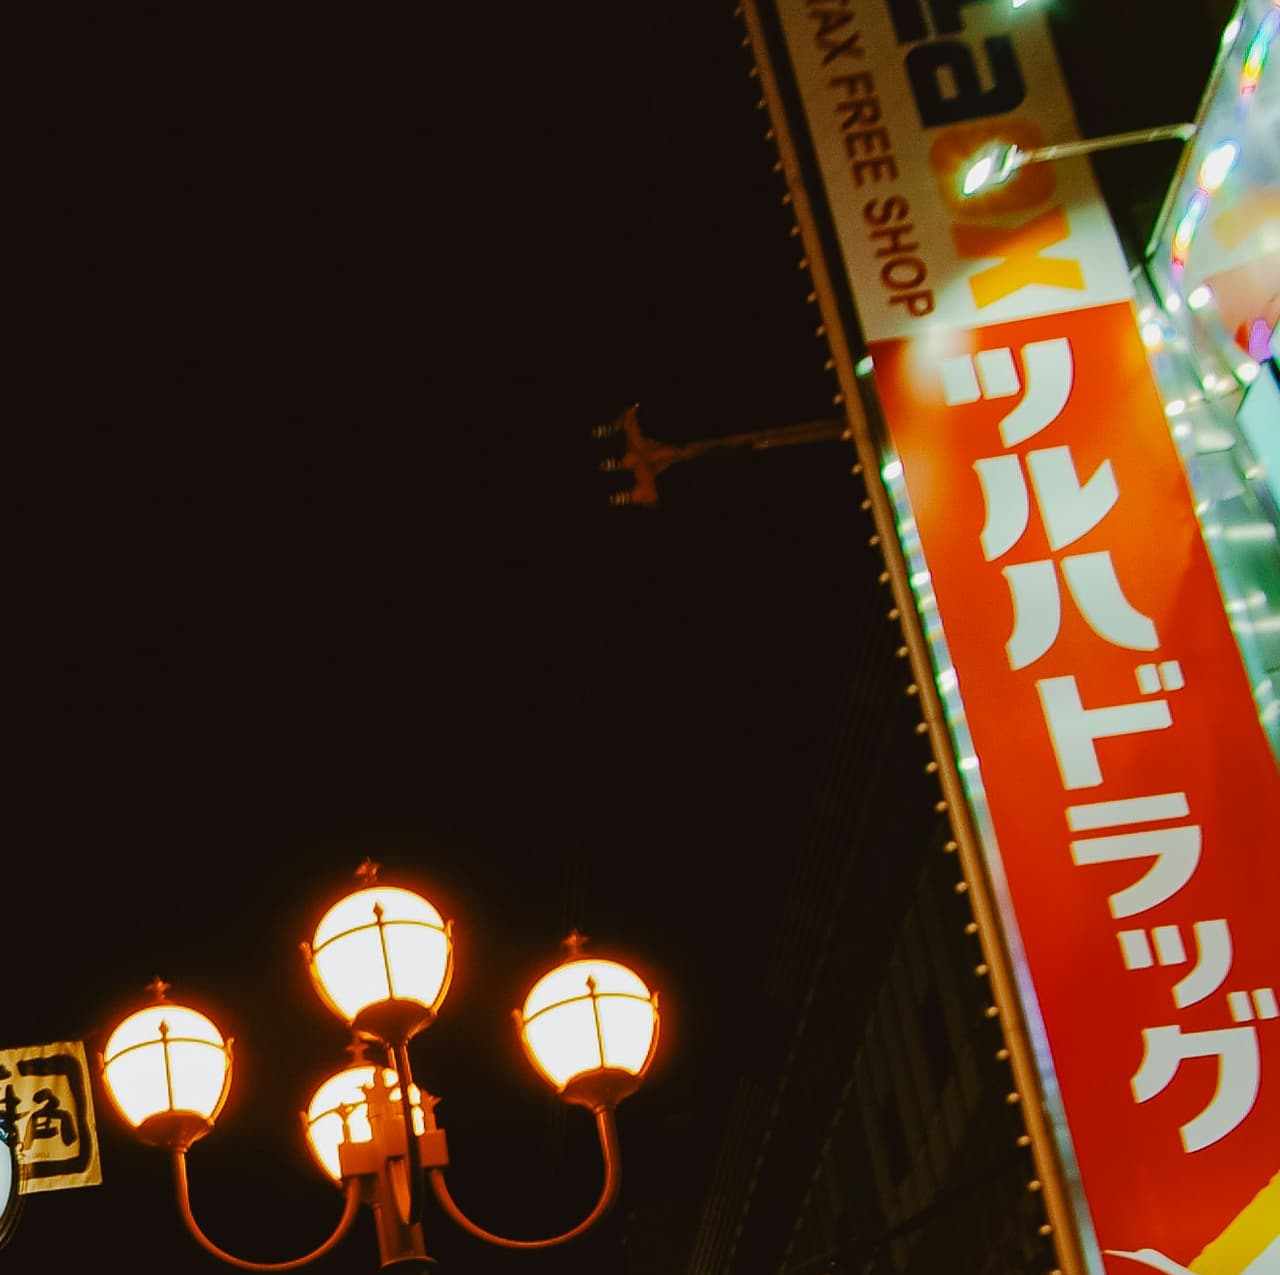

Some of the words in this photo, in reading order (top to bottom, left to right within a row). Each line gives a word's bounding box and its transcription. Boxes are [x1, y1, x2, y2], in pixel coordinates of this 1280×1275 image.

[806, 0, 855, 66] AX
[836, 70, 899, 187] FREE
[863, 198, 937, 318] SHOP
[943, 337, 1278, 1153] ツルハドラッグ
